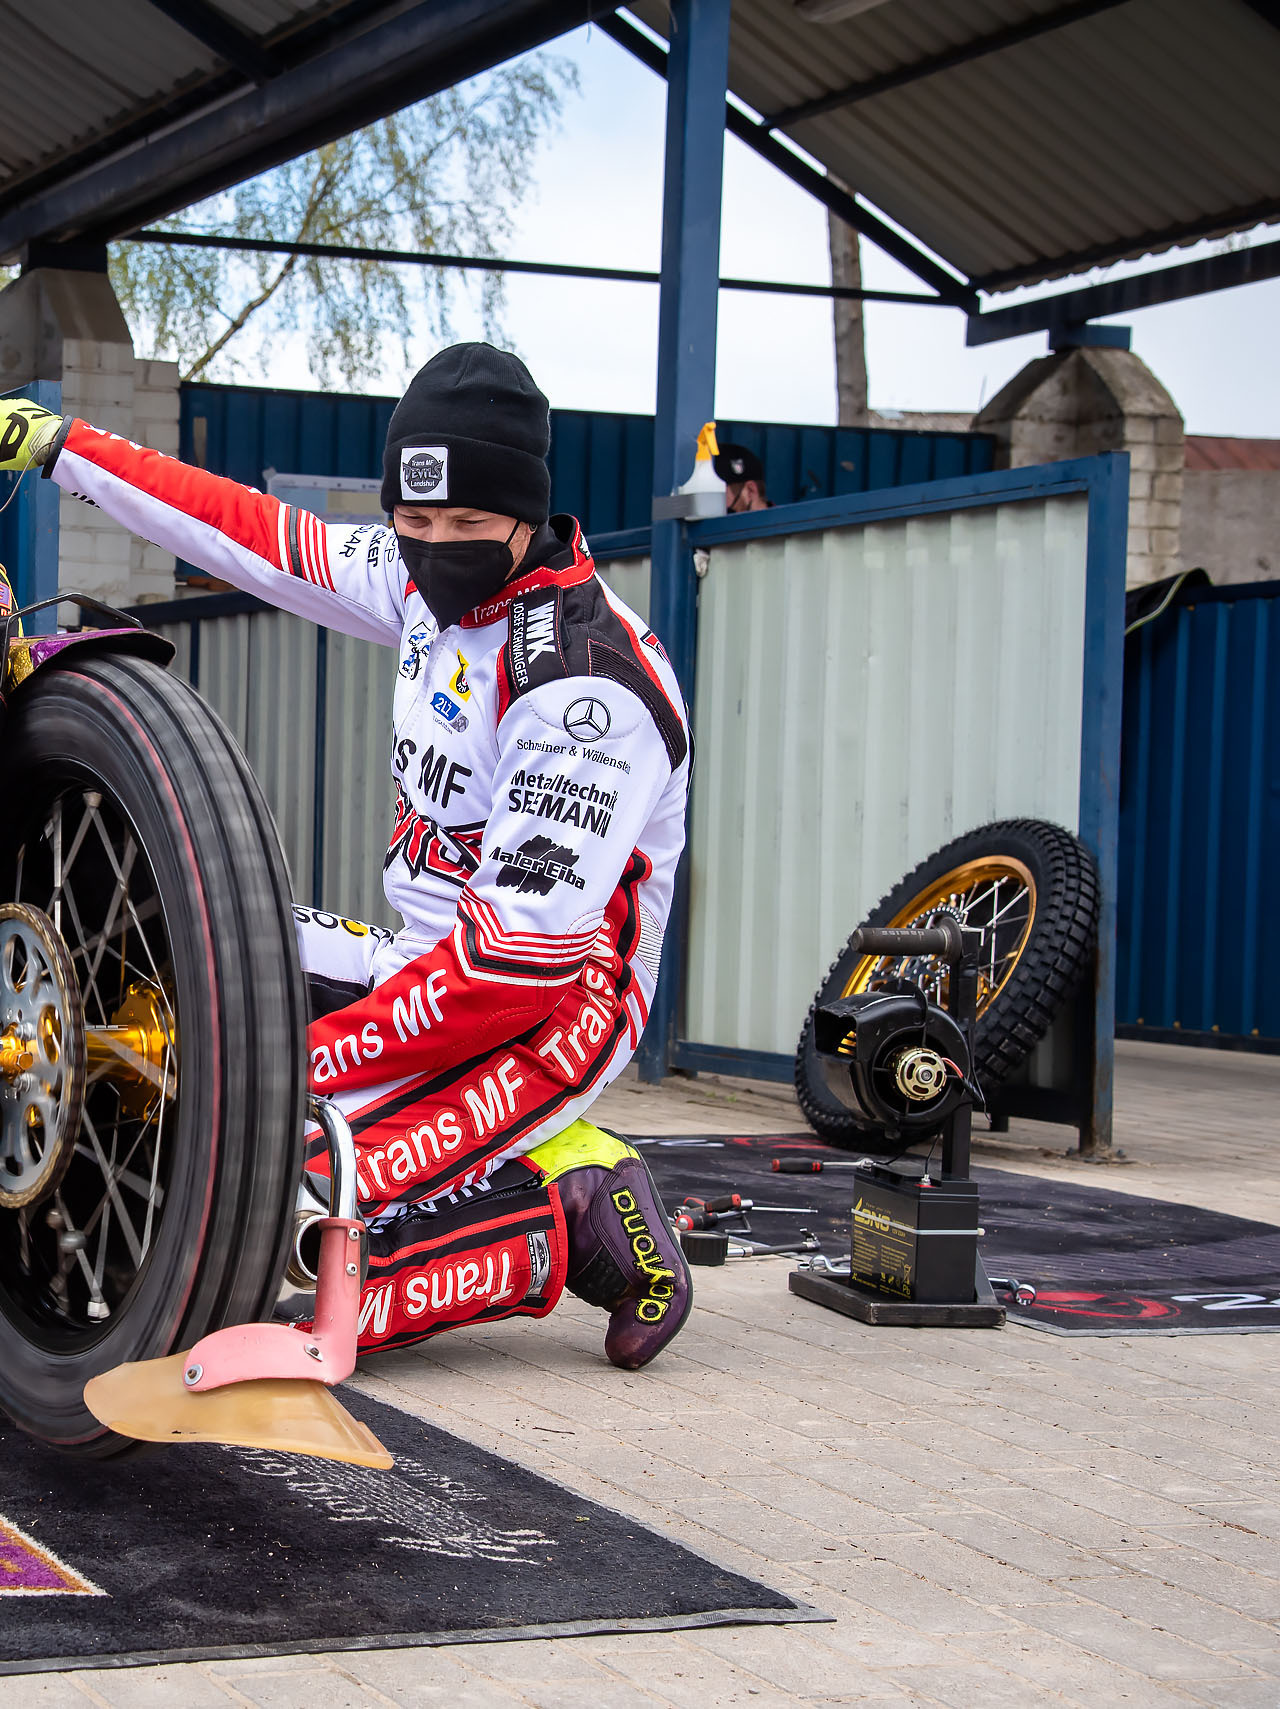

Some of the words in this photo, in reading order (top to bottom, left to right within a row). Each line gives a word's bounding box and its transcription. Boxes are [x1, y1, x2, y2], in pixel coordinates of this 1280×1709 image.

[512, 602, 525, 627] JOSEF
[525, 599, 557, 665] WWK
[512, 627, 529, 688] SCHWAIGER
[417, 744, 473, 809] MF
[516, 739, 567, 755] Schreiner
[568, 745, 578, 757] &
[545, 861, 586, 891] Eiba
[311, 1021, 384, 1084] ans
[392, 968, 448, 1043] MF
[465, 1057, 524, 1137] MF
[406, 1250, 513, 1316] Trans
[611, 1188, 677, 1323] daytona
[357, 1284, 393, 1335] M
